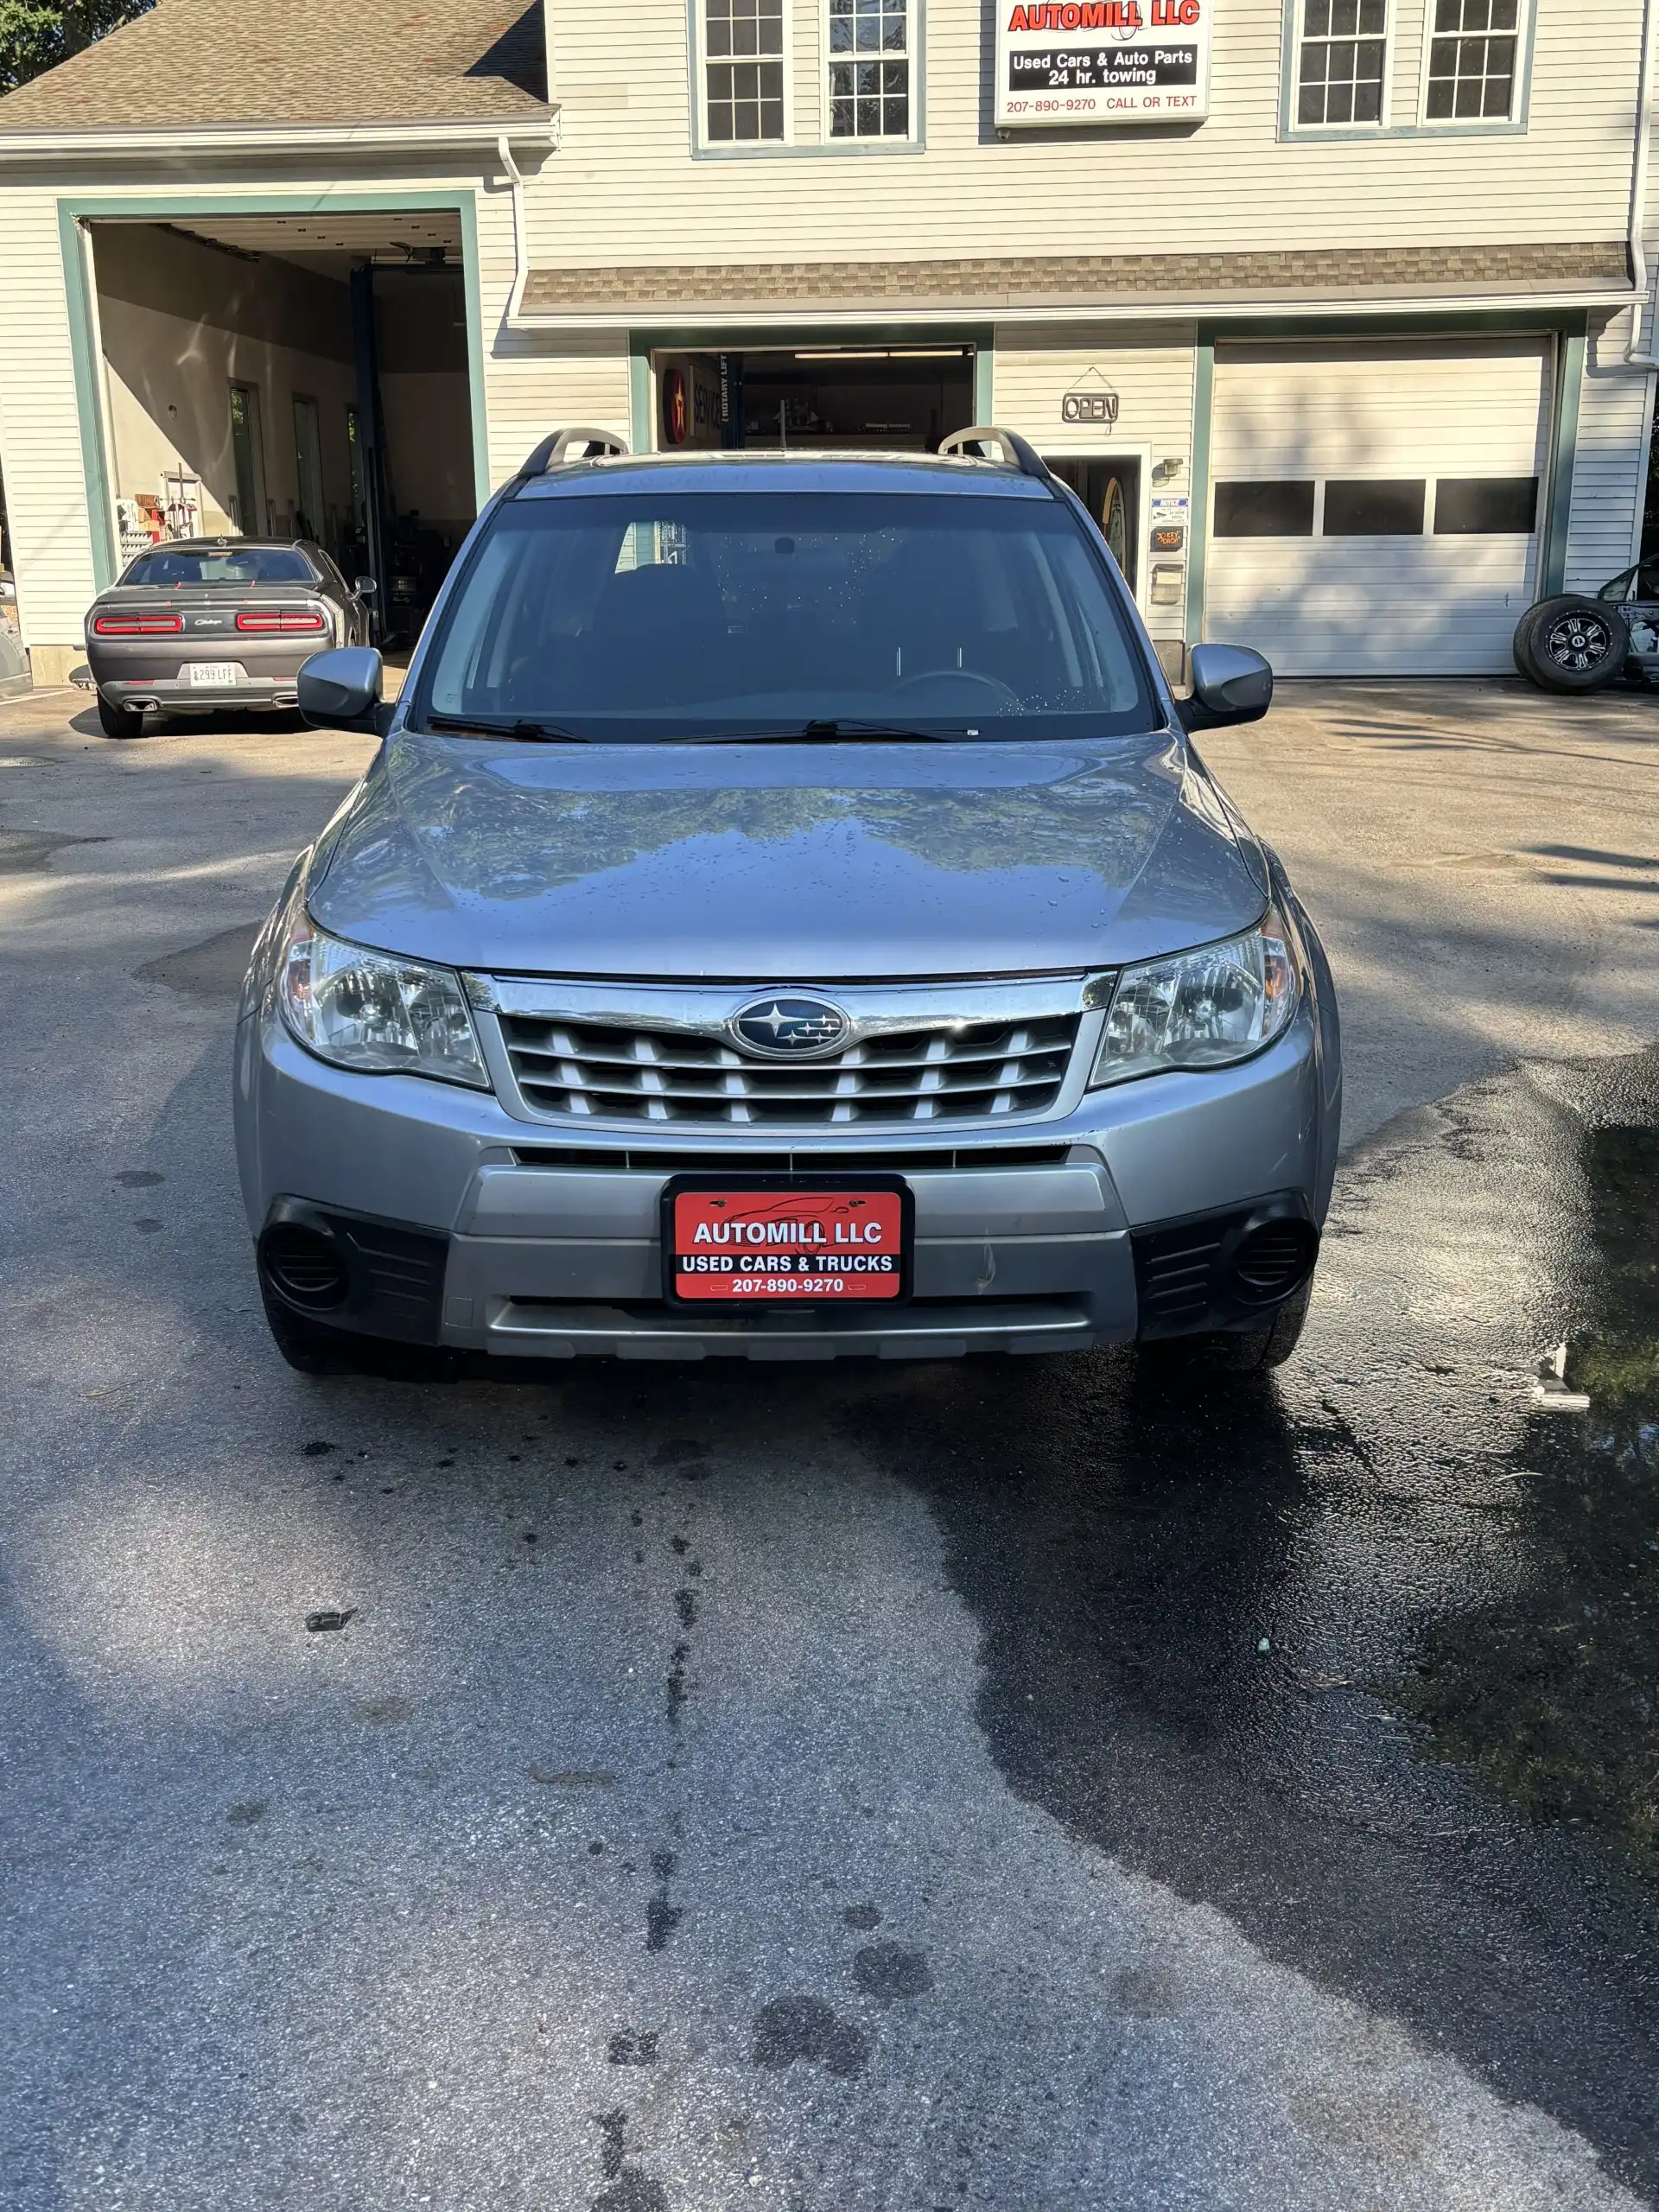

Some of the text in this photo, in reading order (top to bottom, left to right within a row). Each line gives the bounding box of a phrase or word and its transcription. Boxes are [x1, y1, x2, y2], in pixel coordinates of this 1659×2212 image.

[1007, 0, 1200, 31] AUTOMILL LLC
[1014, 50, 1192, 69] Used Cars & Auto Parts
[1049, 68, 1156, 85] 24 hr. towing
[1007, 96, 1197, 112] 207-890-9270 CALL OR TEXT
[1065, 397, 1116, 419] OPEN
[693, 1223, 882, 1244] AUTOMILL LLC
[683, 1255, 893, 1272] USED CARS & TRUCKS
[732, 1279, 843, 1293] 207-890-9270
